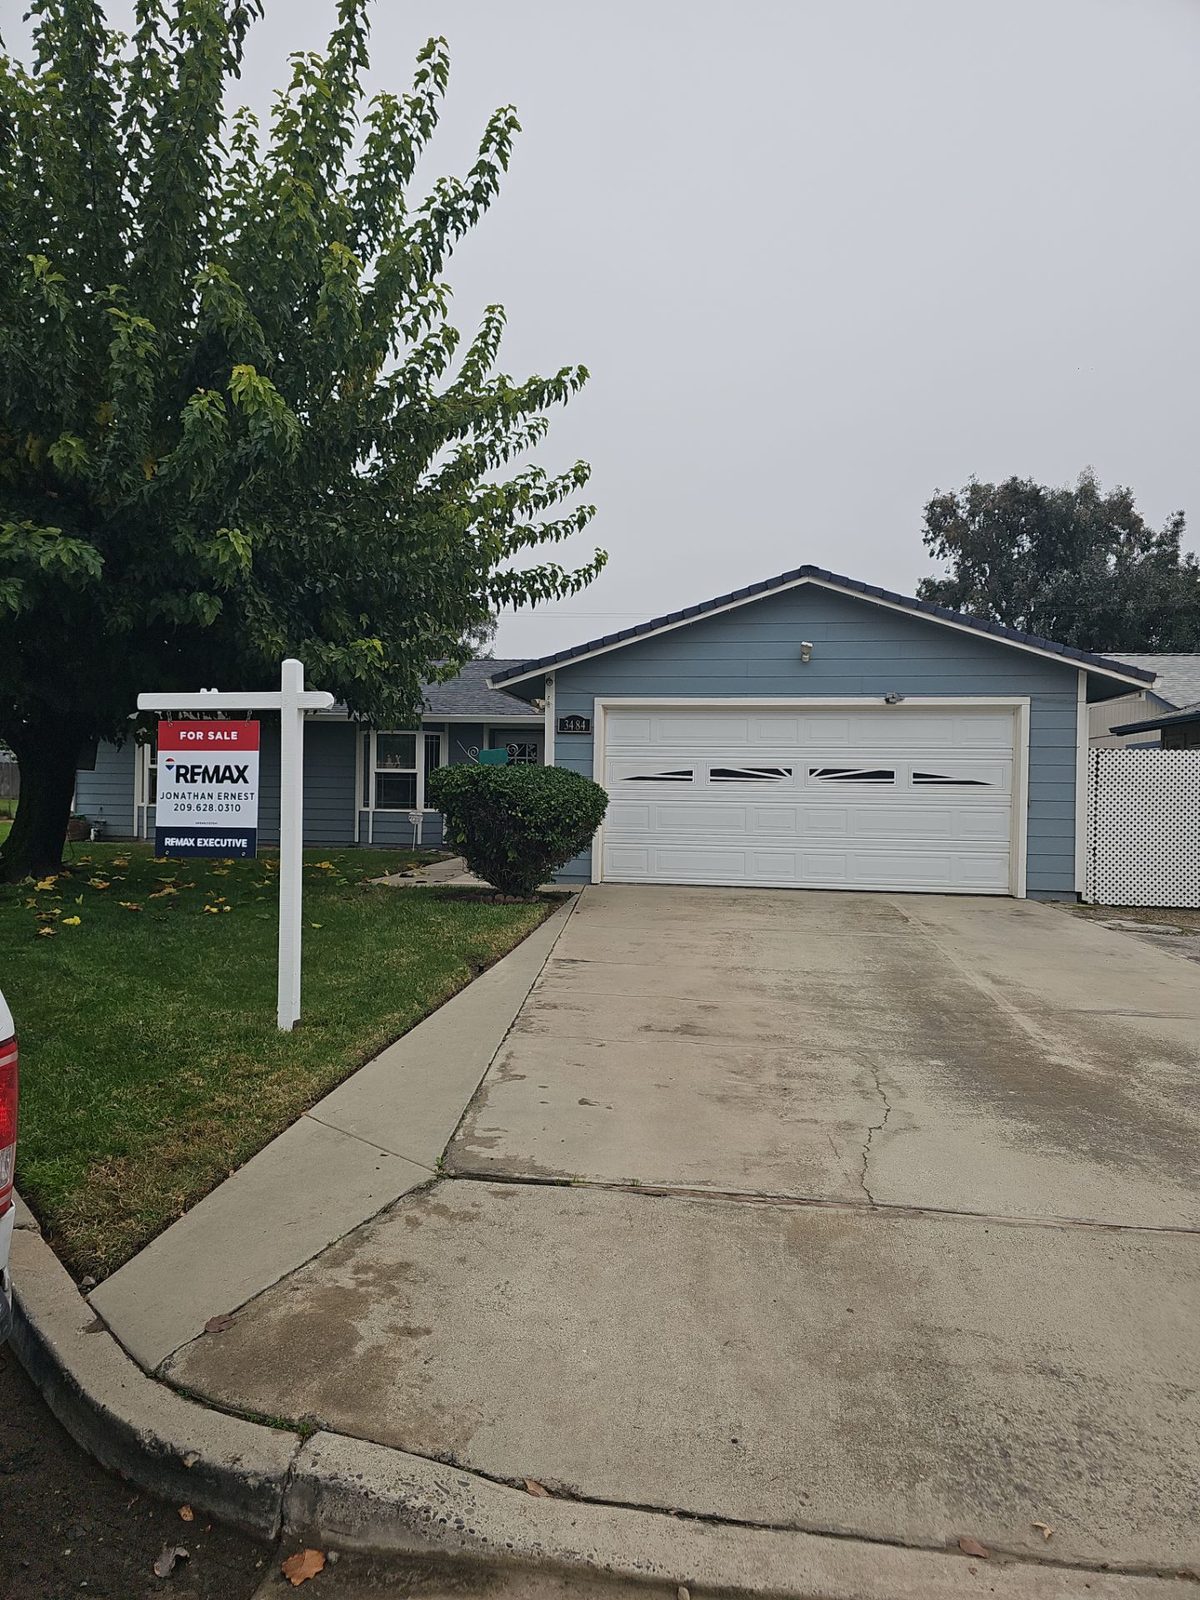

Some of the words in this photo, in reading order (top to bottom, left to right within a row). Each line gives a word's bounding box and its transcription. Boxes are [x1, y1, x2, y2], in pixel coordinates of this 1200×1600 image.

[563, 719, 586, 731] 3484
[179, 731, 204, 740] FOR
[207, 731, 238, 740] SALE
[160, 791, 214, 800] JONATHAN
[217, 792, 256, 801] ERNEST
[173, 803, 241, 812] 209.628.0310
[196, 838, 248, 848] EXECUTIVE
